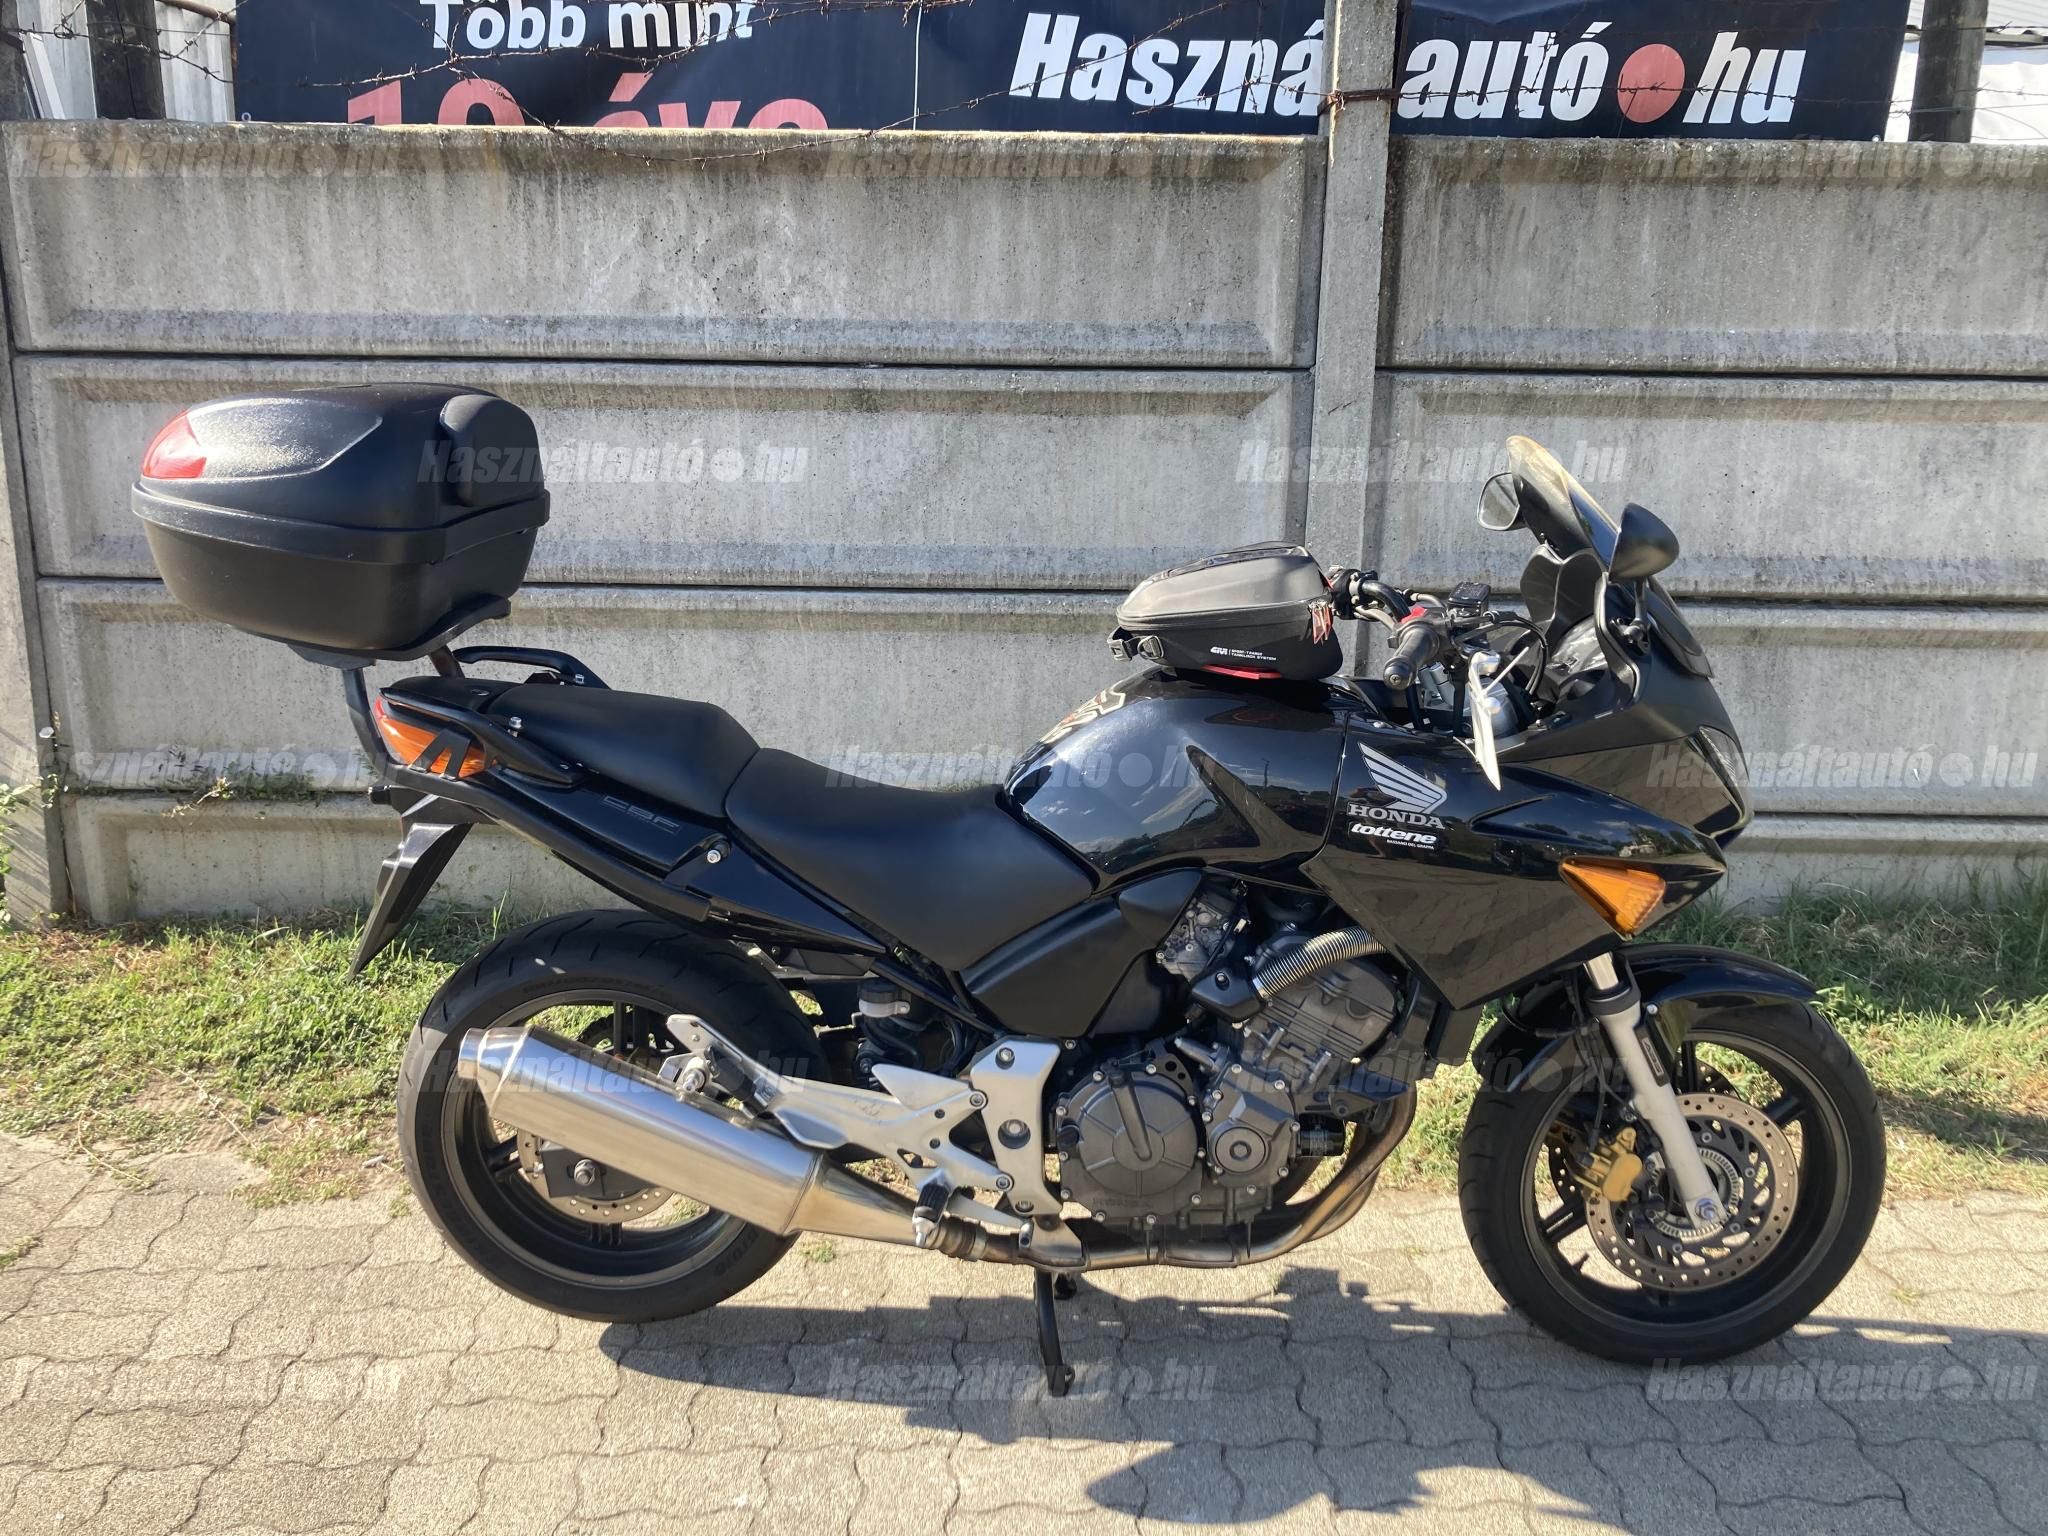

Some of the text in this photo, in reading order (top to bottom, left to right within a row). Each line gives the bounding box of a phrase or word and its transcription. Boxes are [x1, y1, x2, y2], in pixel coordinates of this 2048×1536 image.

[420, 0, 753, 49] Több mint
[1348, 804, 1446, 830] HONDA
[1351, 823, 1437, 844] tottene
